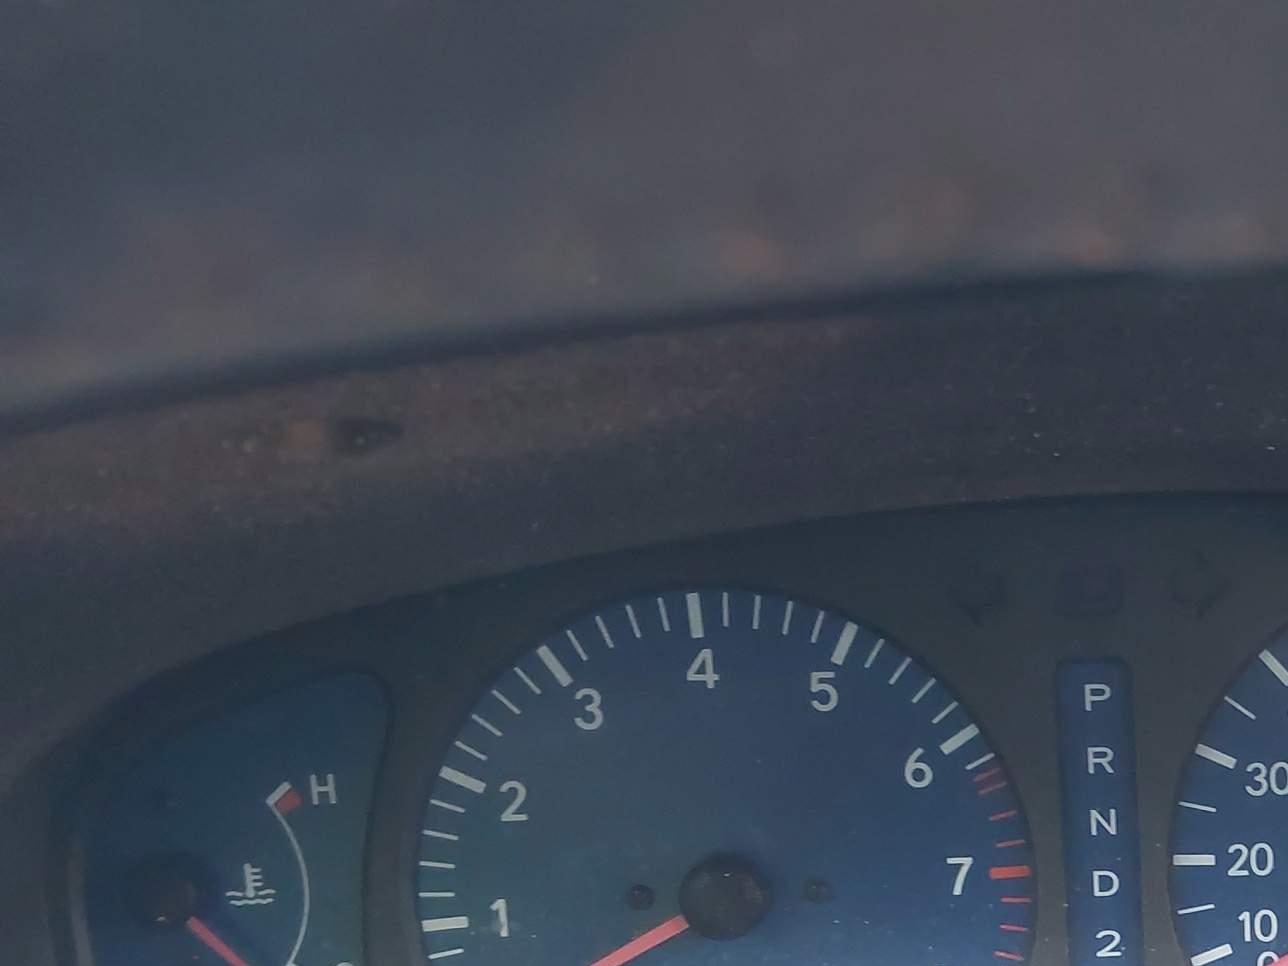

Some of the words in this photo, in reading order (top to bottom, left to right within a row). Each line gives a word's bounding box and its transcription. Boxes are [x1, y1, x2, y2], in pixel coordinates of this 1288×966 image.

[686, 649, 720, 689] 4
[573, 687, 604, 730] 3
[809, 672, 838, 712] 5
[1084, 684, 1111, 711] P
[904, 747, 933, 788] 6
[1087, 747, 1115, 775] R
[310, 774, 337, 805] H
[500, 781, 529, 822] 2
[1091, 808, 1117, 836] N
[946, 857, 974, 896] 7
[1227, 842, 1274, 877] 20
[1092, 870, 1119, 897] D
[489, 899, 510, 937] 1
[1237, 908, 1278, 943] 10
[1095, 929, 1122, 957] 2
